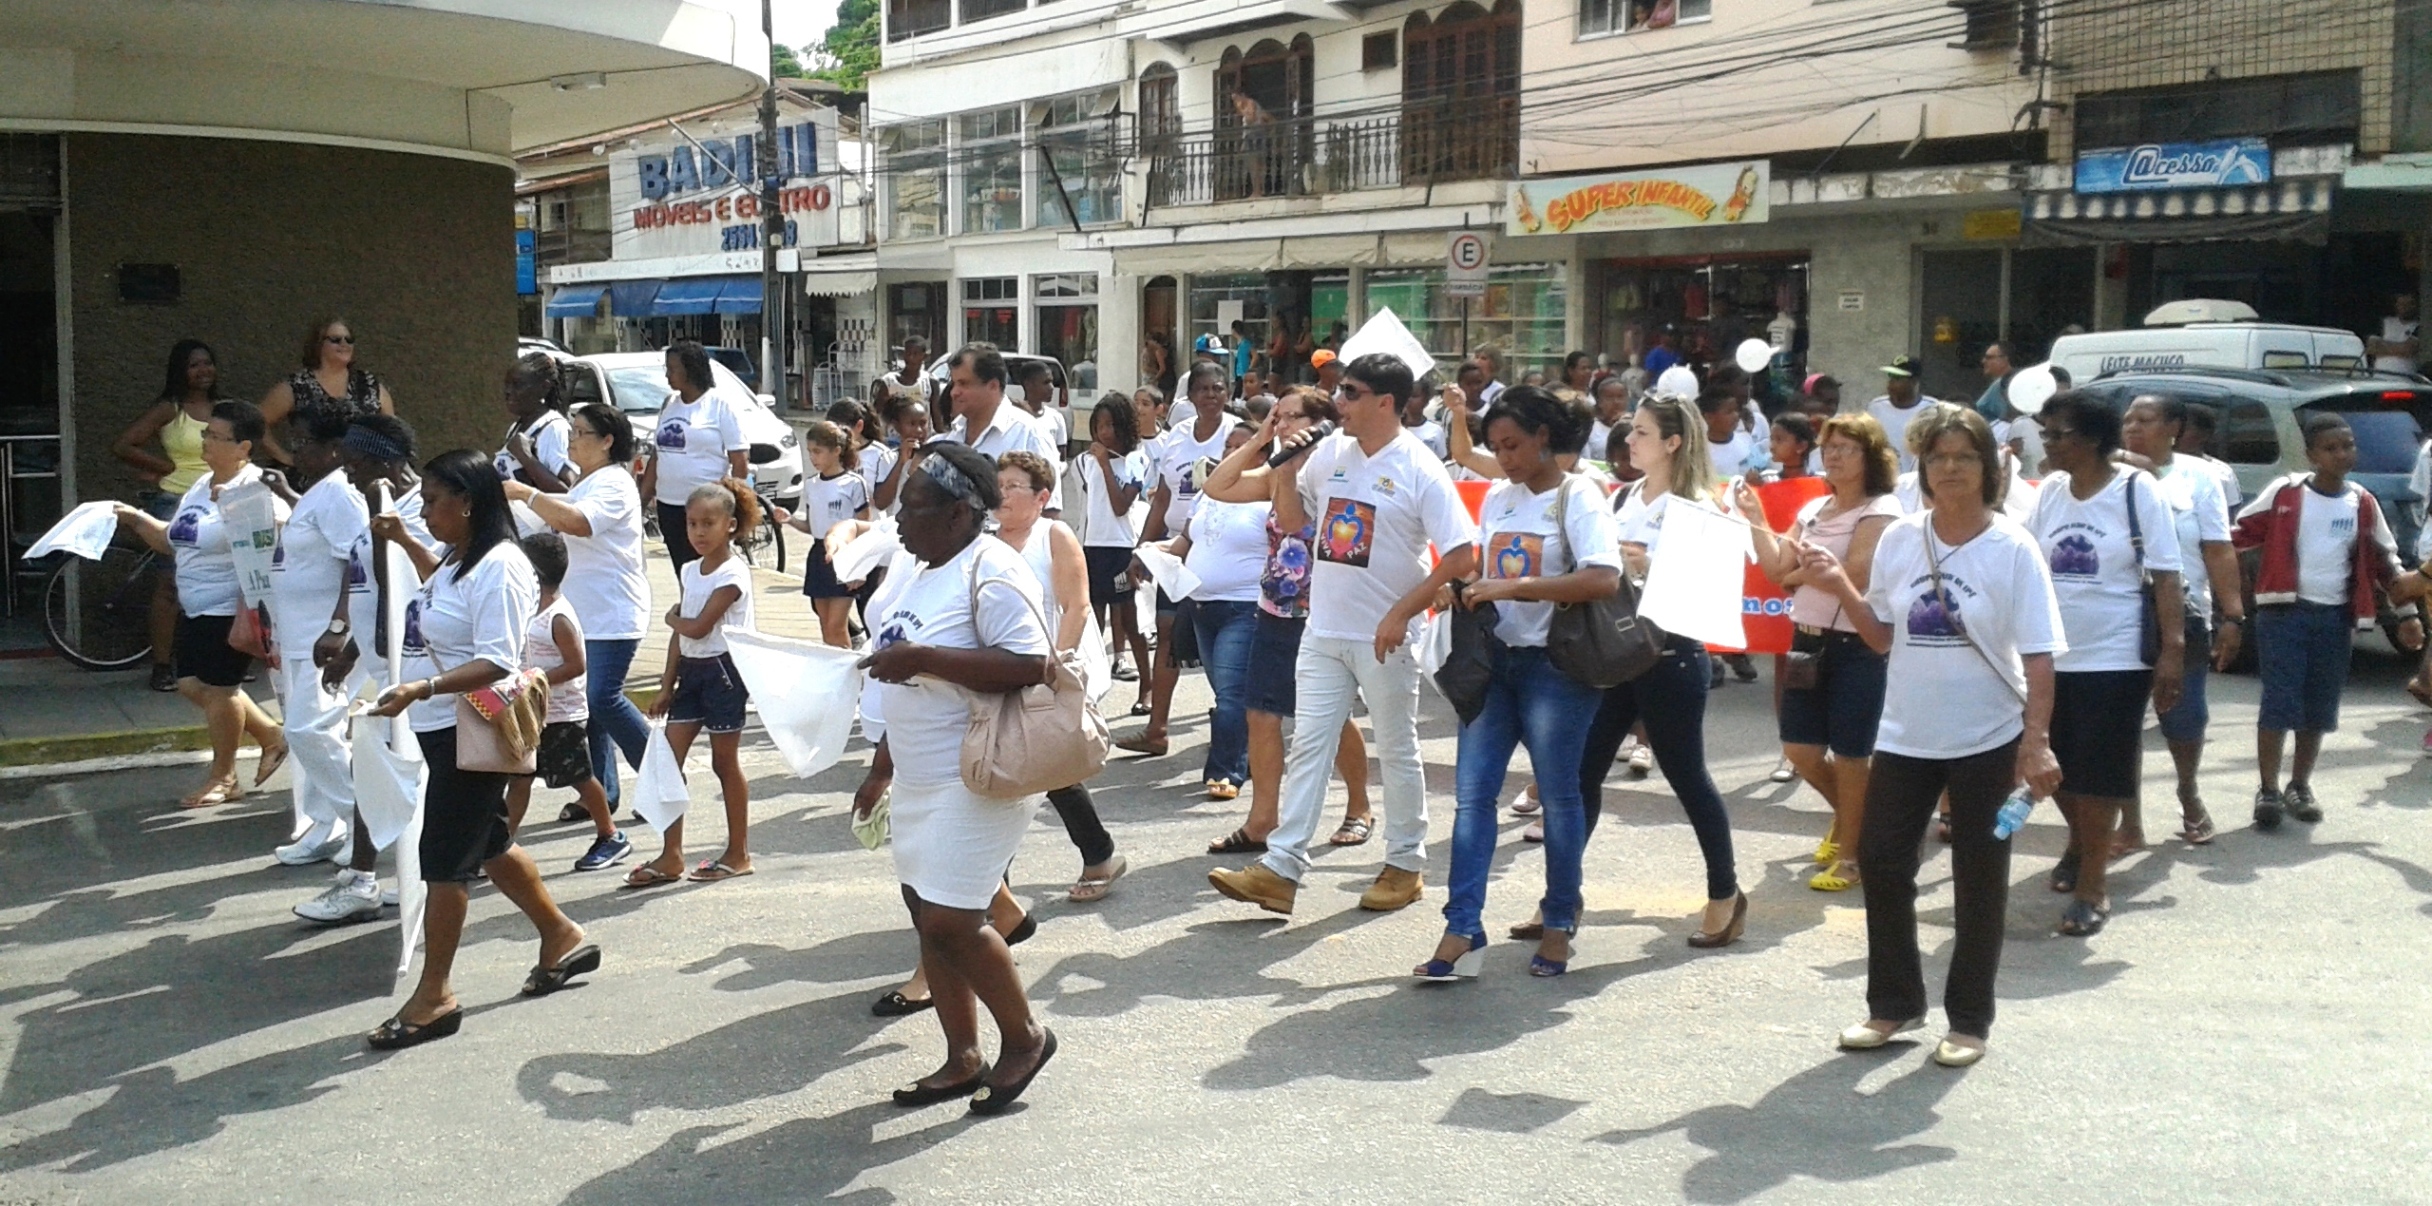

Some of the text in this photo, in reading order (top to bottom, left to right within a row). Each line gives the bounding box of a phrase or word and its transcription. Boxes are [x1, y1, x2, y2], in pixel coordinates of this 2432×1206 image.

[715, 196, 731, 220] E
[734, 184, 831, 219] ELTRO
[1546, 179, 1716, 233] SUPER INFANTIL
[1463, 243, 1474, 262] E
[2100, 354, 2185, 374] LEITE MACUCO
[1346, 542, 1367, 558] PAZ
